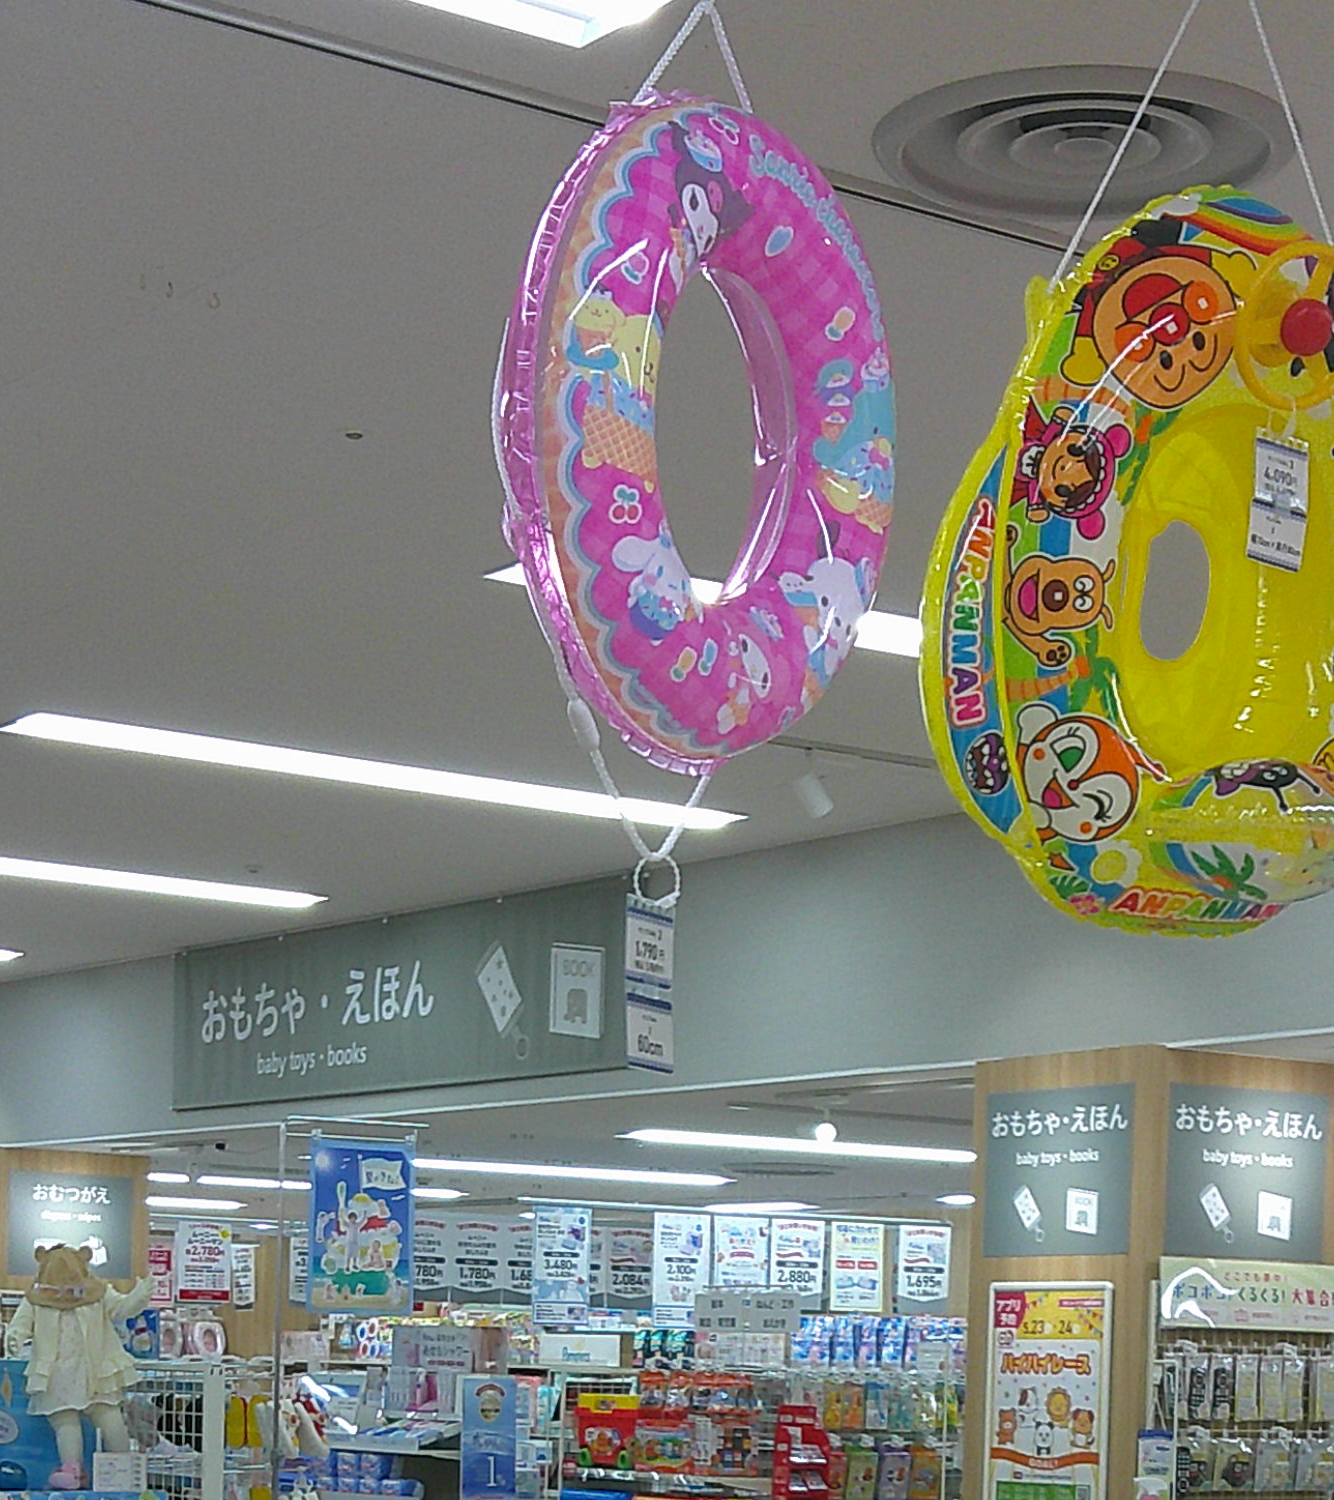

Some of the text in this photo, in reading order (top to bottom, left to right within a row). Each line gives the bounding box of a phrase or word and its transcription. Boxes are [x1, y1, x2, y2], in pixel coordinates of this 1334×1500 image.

[949, 498, 996, 728] ANPANMAN
[201, 959, 435, 1046] おもちゃ・えほん
[256, 1042, 367, 1076] baby toys books
[992, 1103, 1129, 1138] おもちゃ・えほん
[1176, 1104, 1323, 1140] おもちゃ・えほん
[1016, 1148, 1099, 1168] baby toys books
[1203, 1149, 1294, 1168] baby toys books
[32, 1184, 111, 1205] おむつがえ
[459, 1266, 496, 1280] 1,780円
[777, 1269, 817, 1284] 2,880円
[996, 1299, 1021, 1312] アプリ
[1000, 1352, 1093, 1376] ハイハイレース
